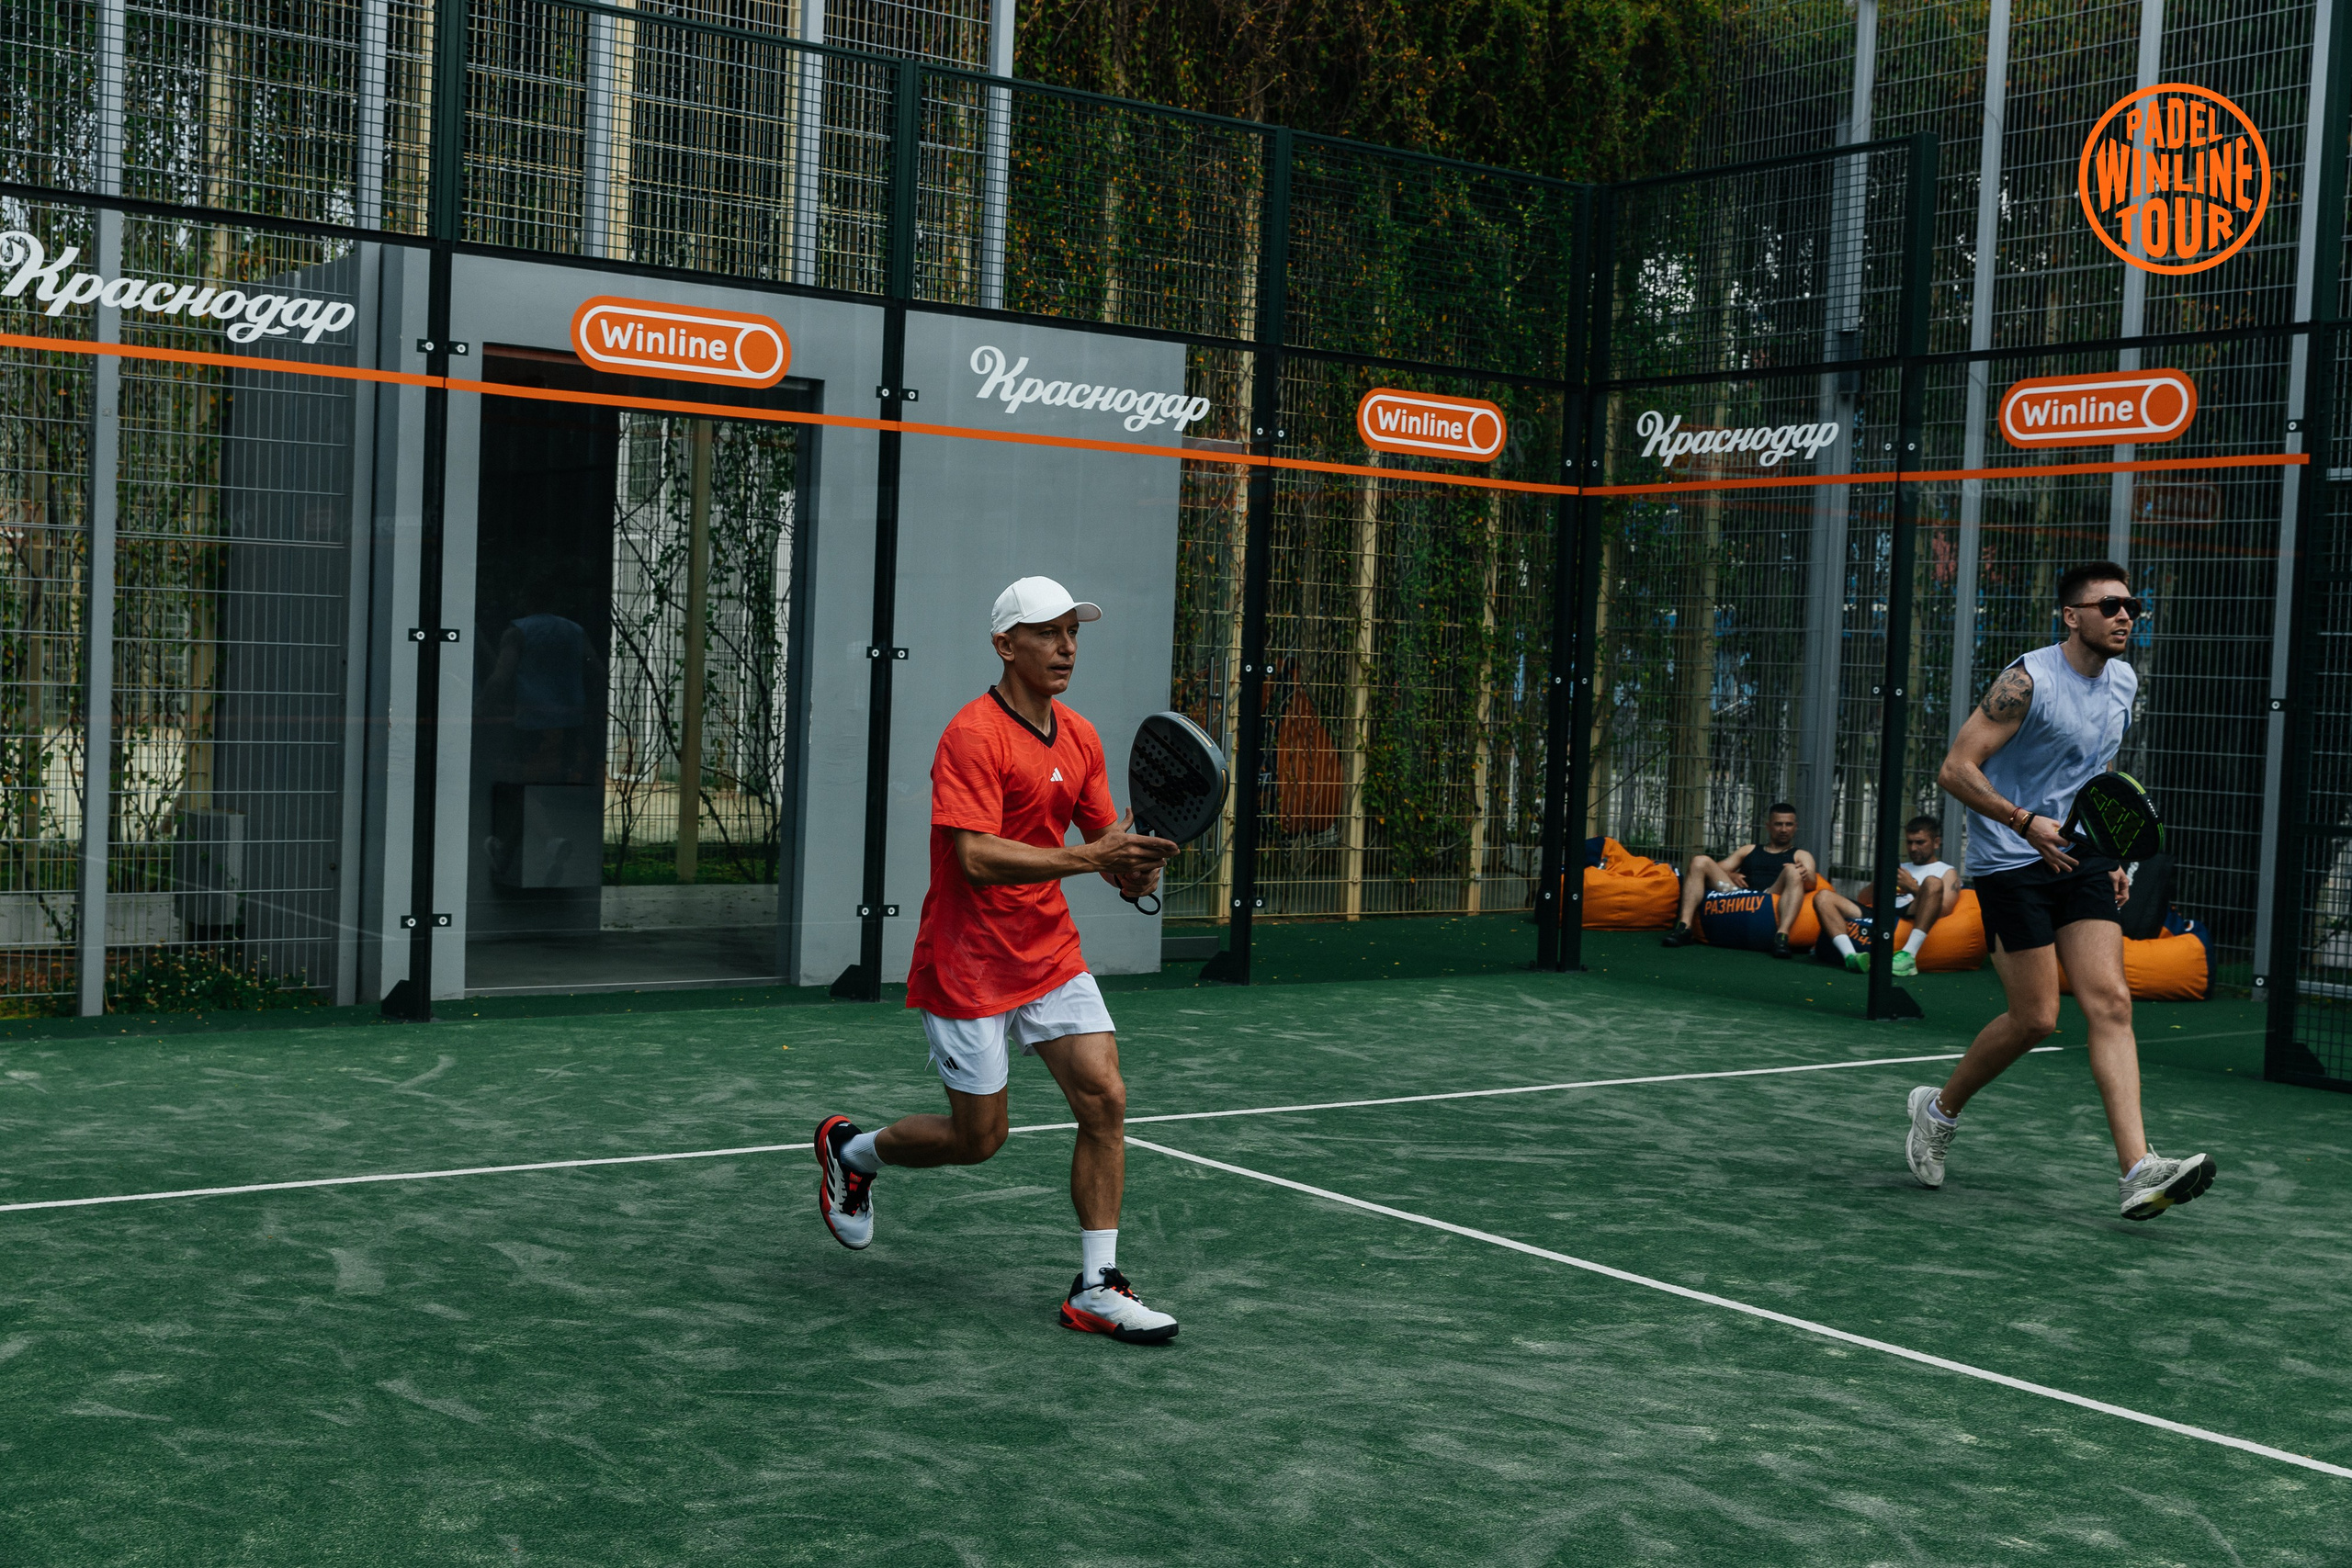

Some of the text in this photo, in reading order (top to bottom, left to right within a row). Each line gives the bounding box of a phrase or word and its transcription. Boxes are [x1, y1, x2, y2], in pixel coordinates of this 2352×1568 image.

[0, 231, 356, 344] Краснодар
[600, 318, 729, 362] Winline
[970, 345, 1210, 432] Краснодар
[1376, 404, 1464, 440] Winline
[2021, 397, 2134, 428] Winline
[1636, 411, 1839, 468] Краснодар
[1704, 895, 1765, 916] РАЗНИЦУ
